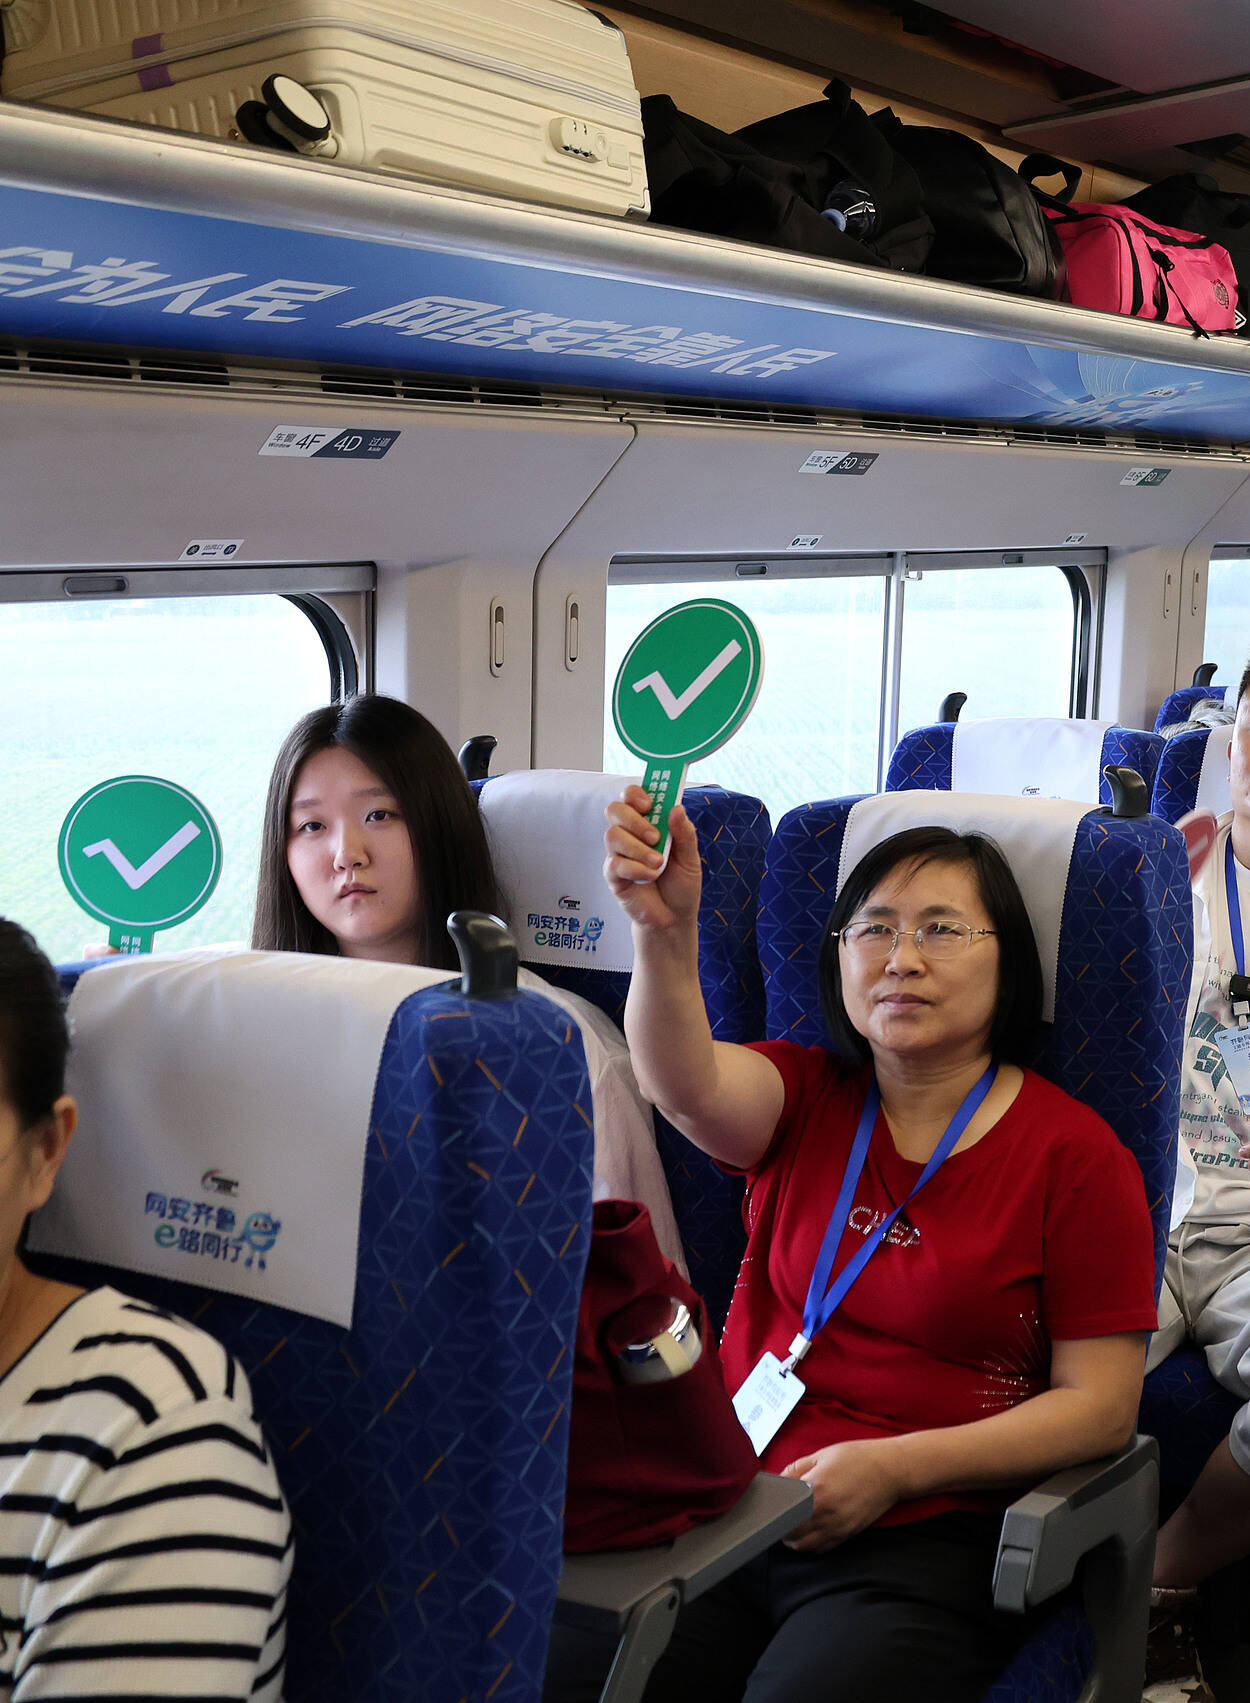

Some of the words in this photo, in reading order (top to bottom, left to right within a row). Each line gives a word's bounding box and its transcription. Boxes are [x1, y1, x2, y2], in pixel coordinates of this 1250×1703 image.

[336, 295, 838, 379] 网络安全靠人民
[295, 434, 326, 449] 4F
[334, 435, 363, 452] 4D
[820, 456, 839, 468] 5F
[527, 913, 580, 933] 网安齐鲁
[534, 931, 585, 951] e路同行
[144, 1191, 237, 1234] 网安齐鲁
[154, 1223, 243, 1264] e路同行
